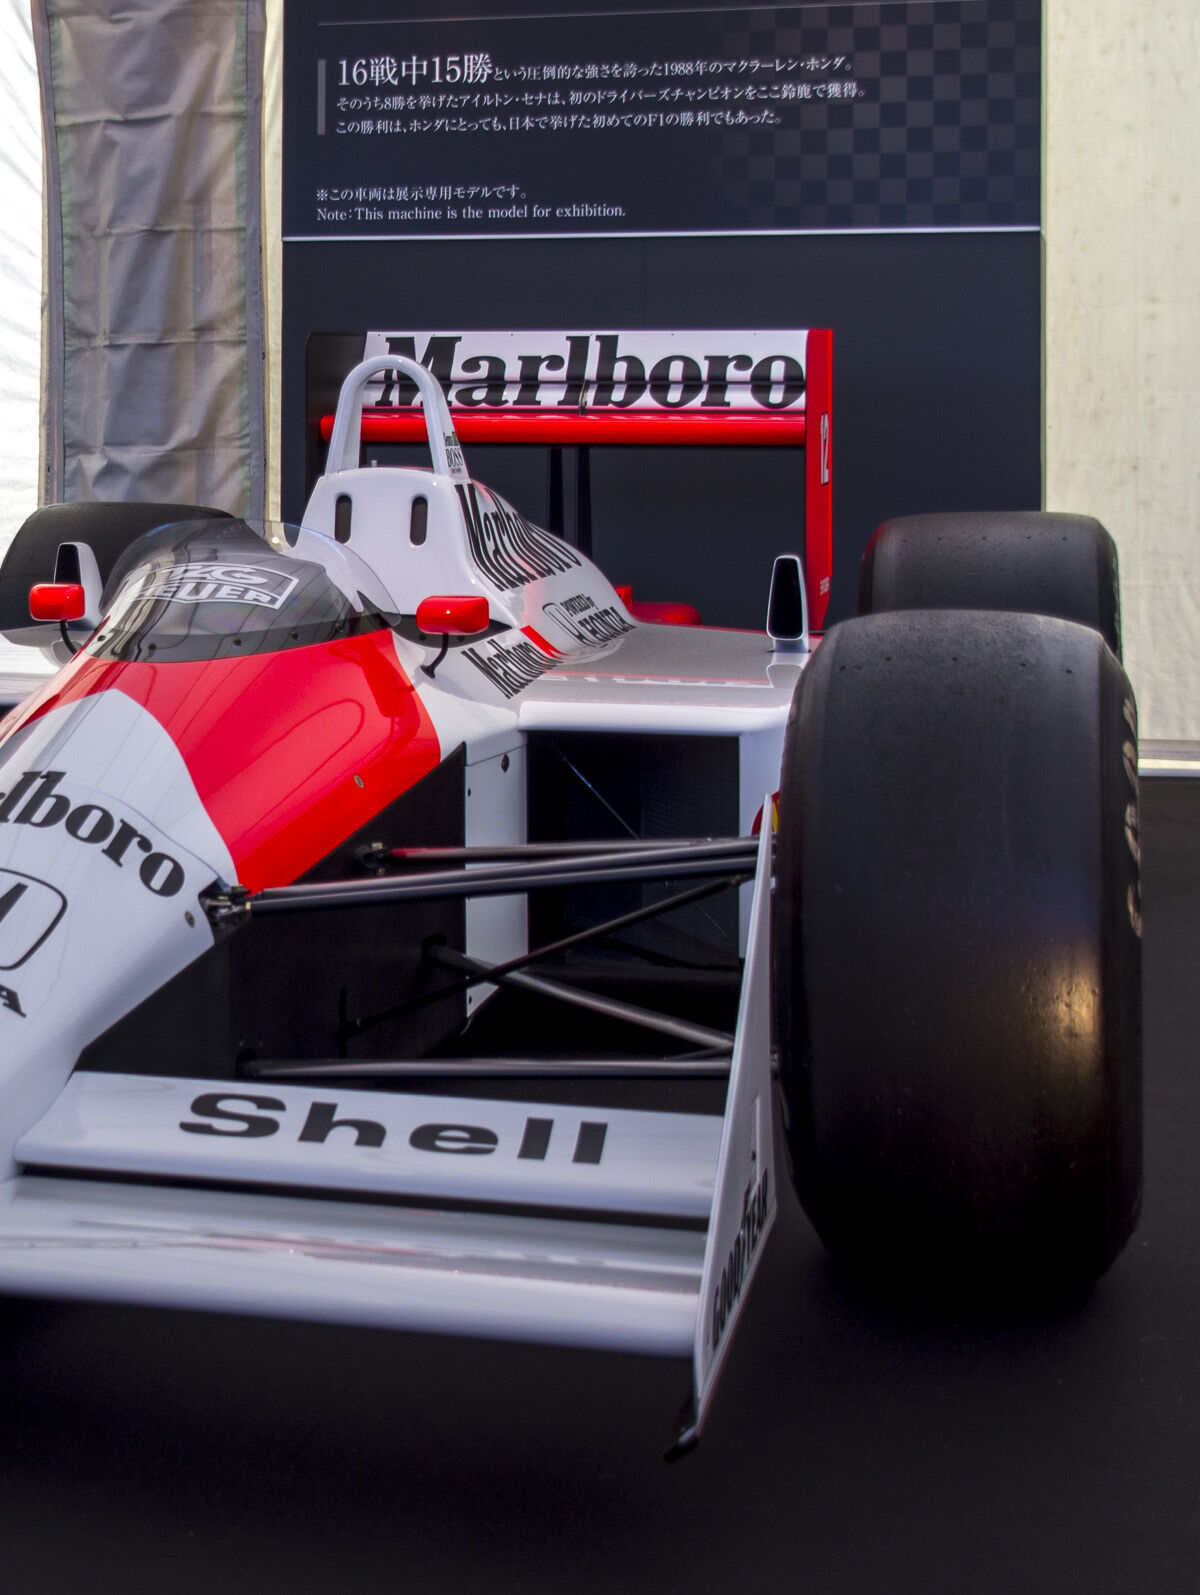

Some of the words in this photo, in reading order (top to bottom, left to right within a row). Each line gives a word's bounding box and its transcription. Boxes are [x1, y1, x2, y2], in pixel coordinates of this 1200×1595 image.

[388, 206, 442, 220] machine
[447, 206, 458, 219] is
[462, 206, 483, 219] the
[488, 205, 528, 218] model
[532, 204, 551, 217] for
[556, 202, 626, 217] exhibition.
[375, 334, 806, 410] Marlboro
[455, 483, 582, 592] Marlboro
[578, 606, 637, 642] HONDA
[179, 1092, 608, 1164] Shell
